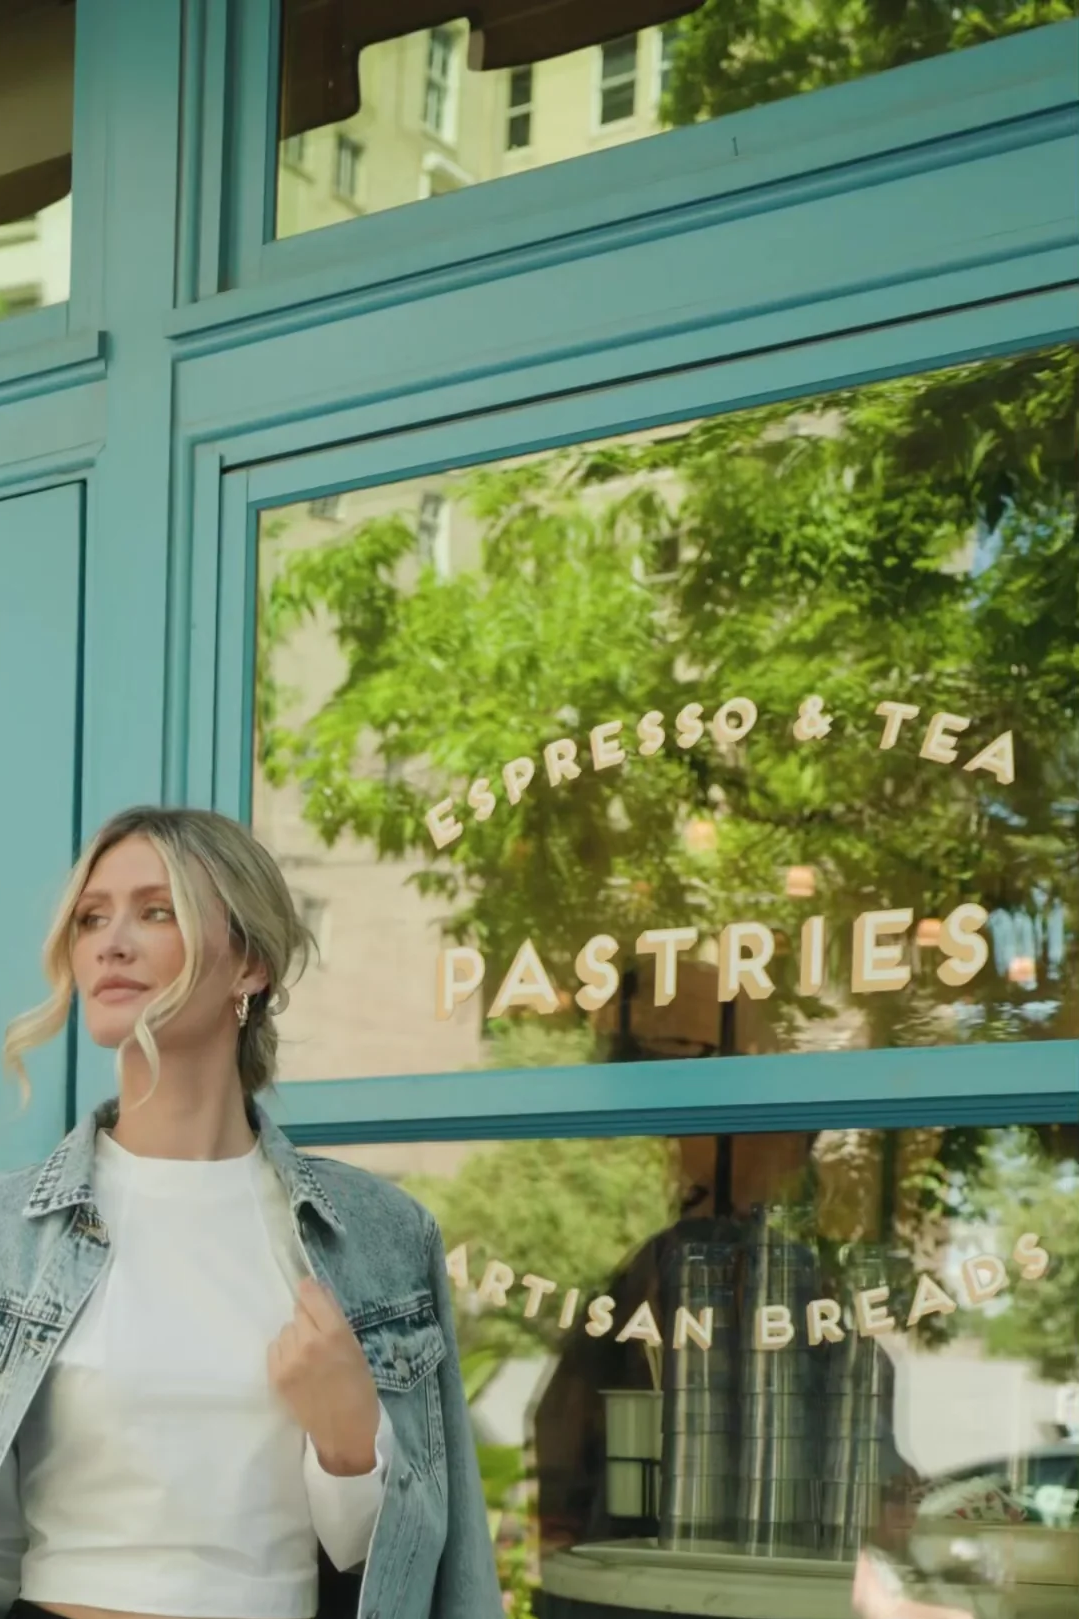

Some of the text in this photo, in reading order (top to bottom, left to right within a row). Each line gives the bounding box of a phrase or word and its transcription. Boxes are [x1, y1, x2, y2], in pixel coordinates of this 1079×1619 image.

[425, 694, 1015, 850] ESPRESSO & TEA
[435, 902, 989, 1021] PASTRIES
[754, 1232, 1049, 1350] BREADS
